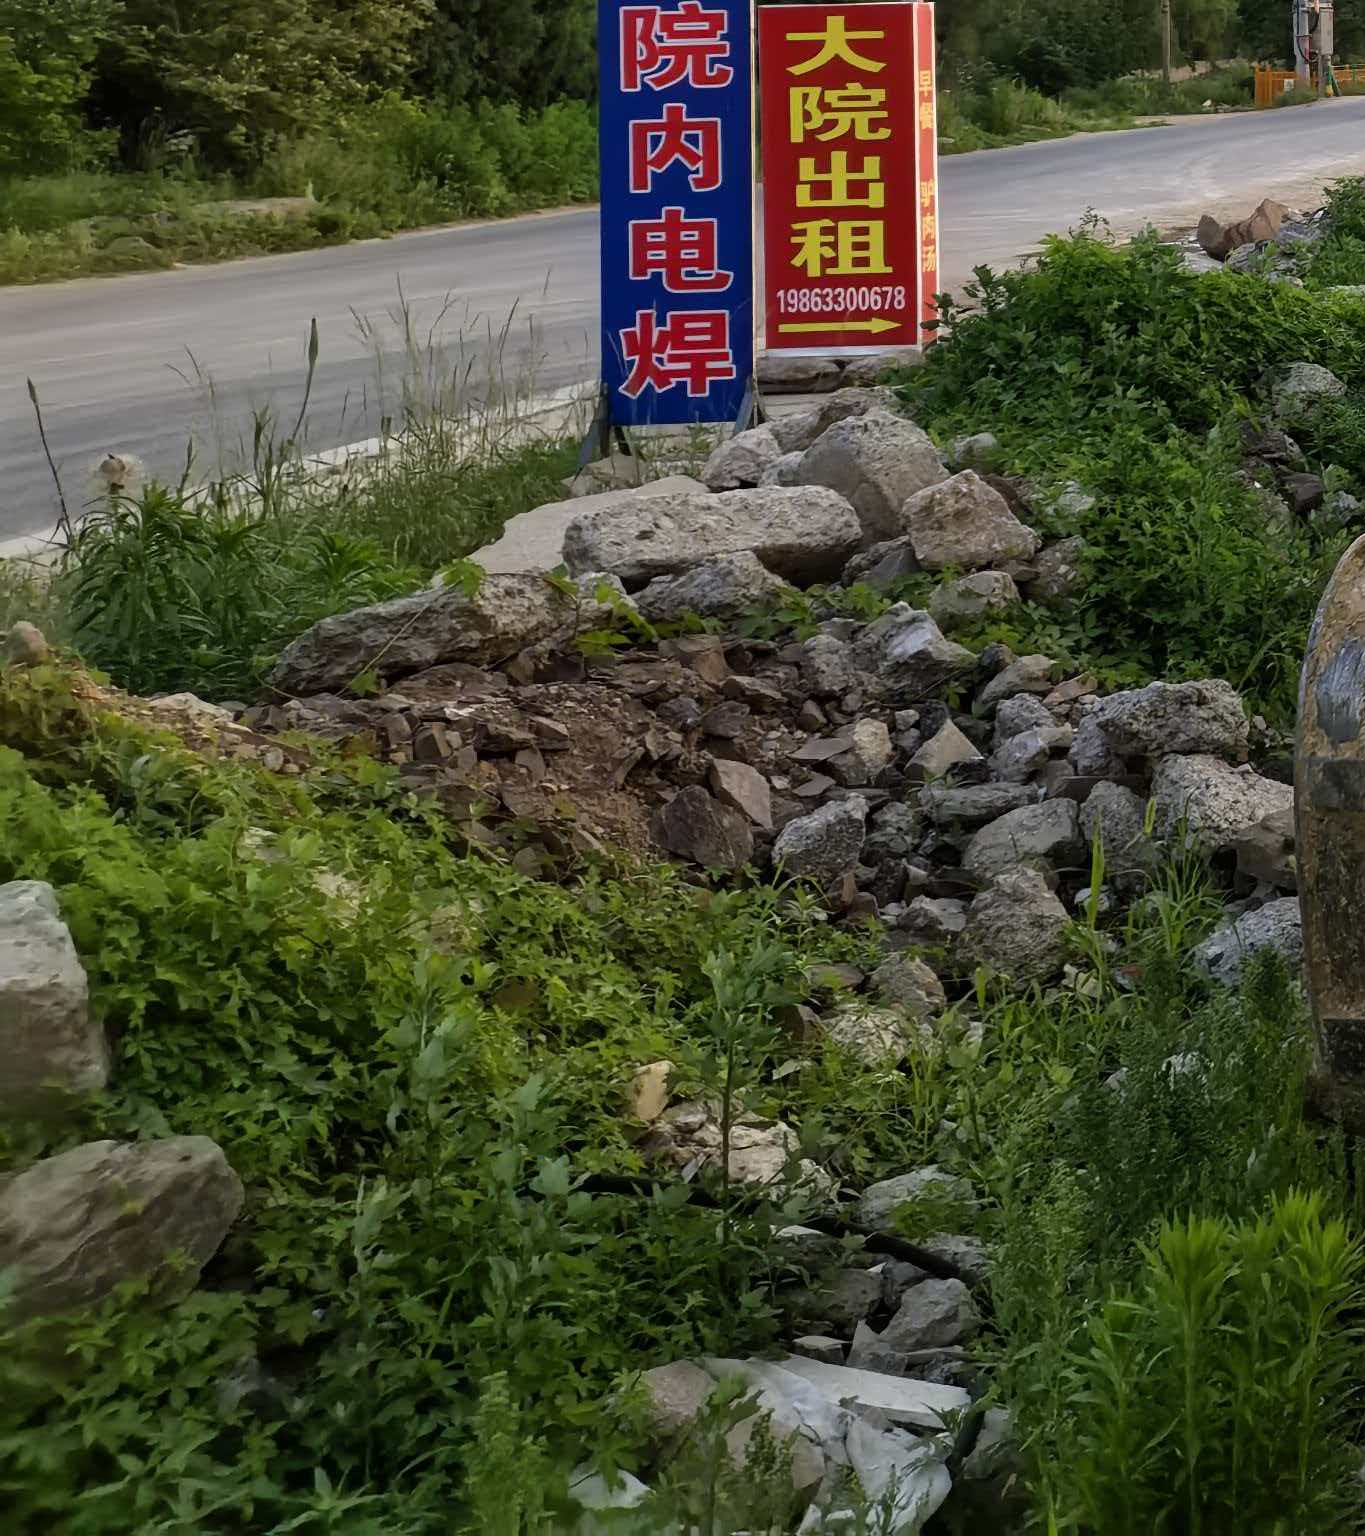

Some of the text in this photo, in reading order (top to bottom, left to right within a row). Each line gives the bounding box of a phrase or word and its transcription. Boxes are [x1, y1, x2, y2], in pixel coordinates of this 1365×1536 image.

[619, 1, 736, 398] 院内电焊
[786, 15, 893, 278] 大院出租
[776, 286, 906, 314] 19863300678
